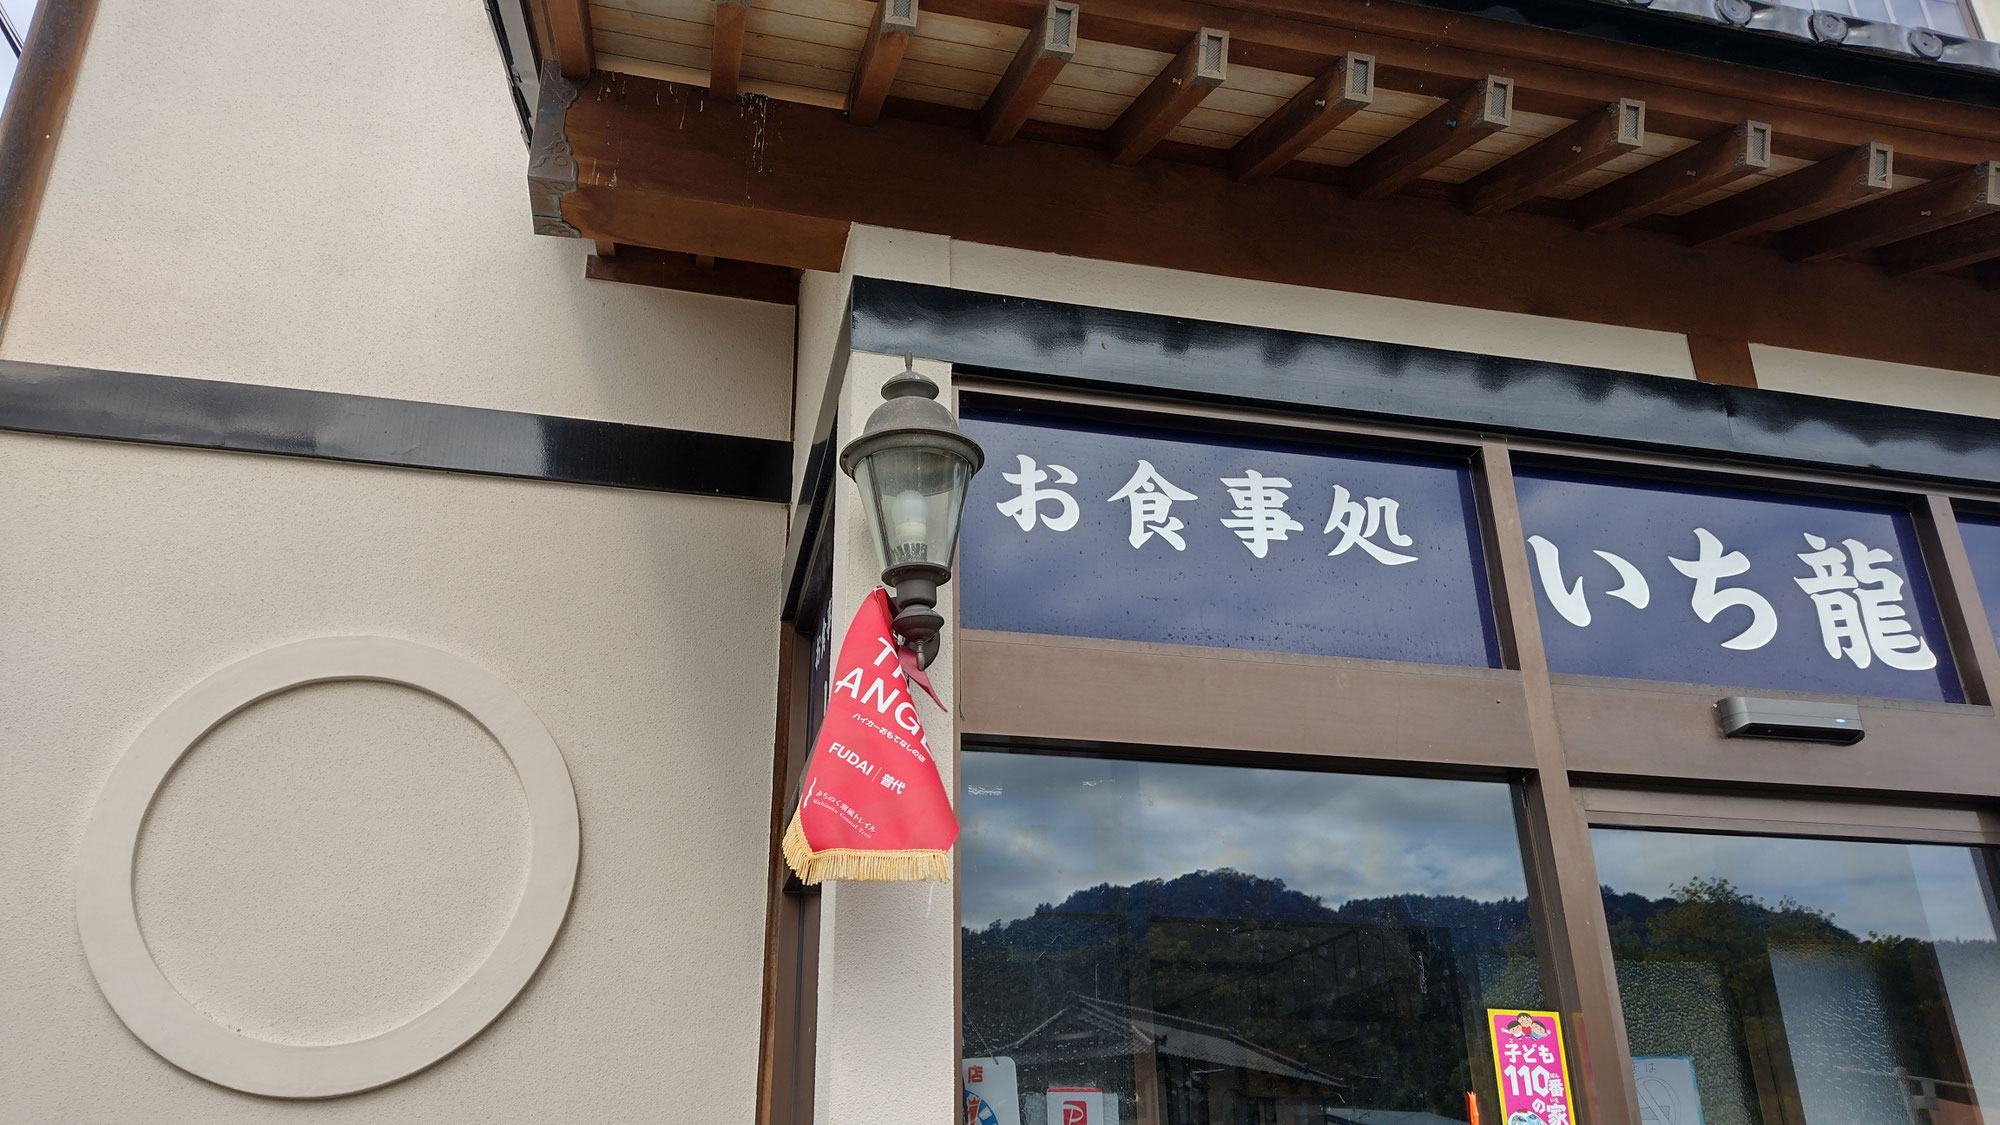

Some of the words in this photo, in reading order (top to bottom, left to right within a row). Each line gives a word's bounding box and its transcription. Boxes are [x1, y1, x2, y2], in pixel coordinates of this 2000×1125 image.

[996, 454, 1419, 565] お食事処
[1527, 527, 1938, 671] いち龍
[828, 742, 874, 776] FUDAI
[880, 774, 906, 794] 普代
[839, 812, 858, 829] Coastal
[858, 828, 872, 839] Trail
[1504, 1043, 1555, 1064] 子ども
